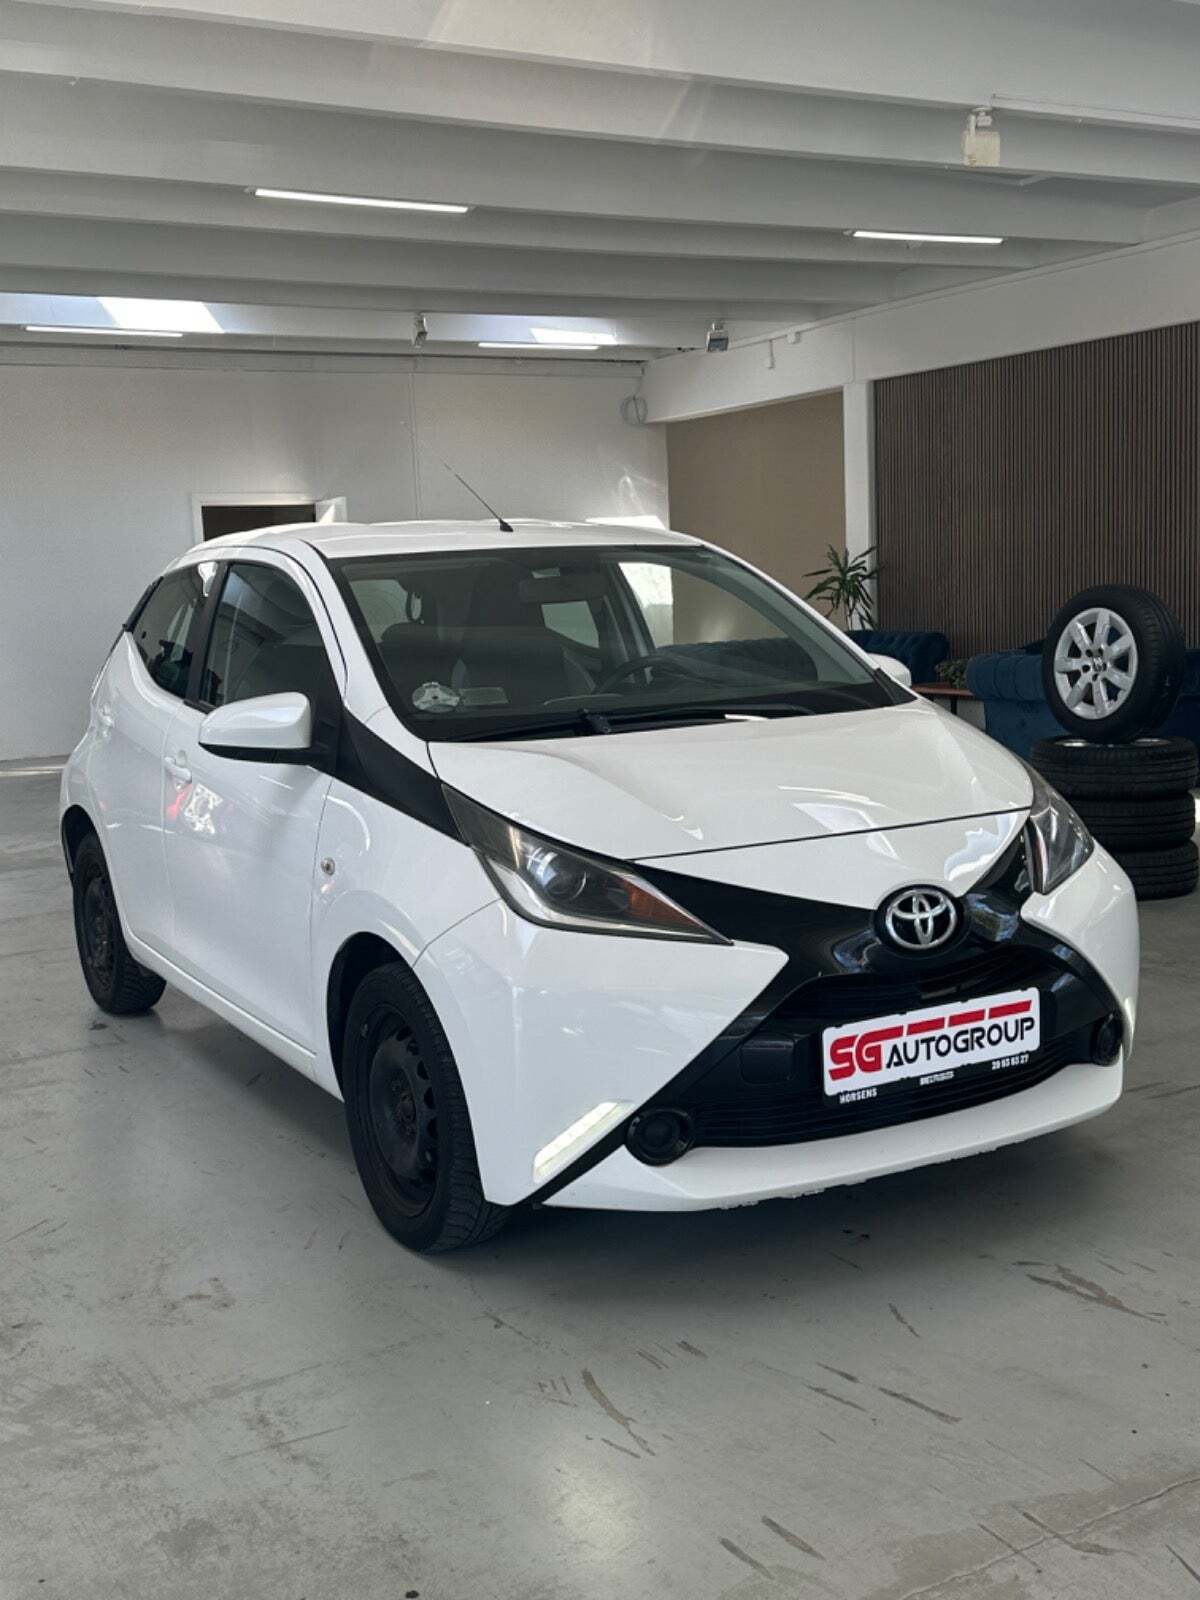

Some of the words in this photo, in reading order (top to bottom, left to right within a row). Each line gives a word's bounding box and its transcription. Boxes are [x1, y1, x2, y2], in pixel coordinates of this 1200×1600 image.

[829, 1025, 903, 1081] SG
[886, 1017, 1035, 1068] AUTOGROUP
[839, 1087, 878, 1104] HORSENS
